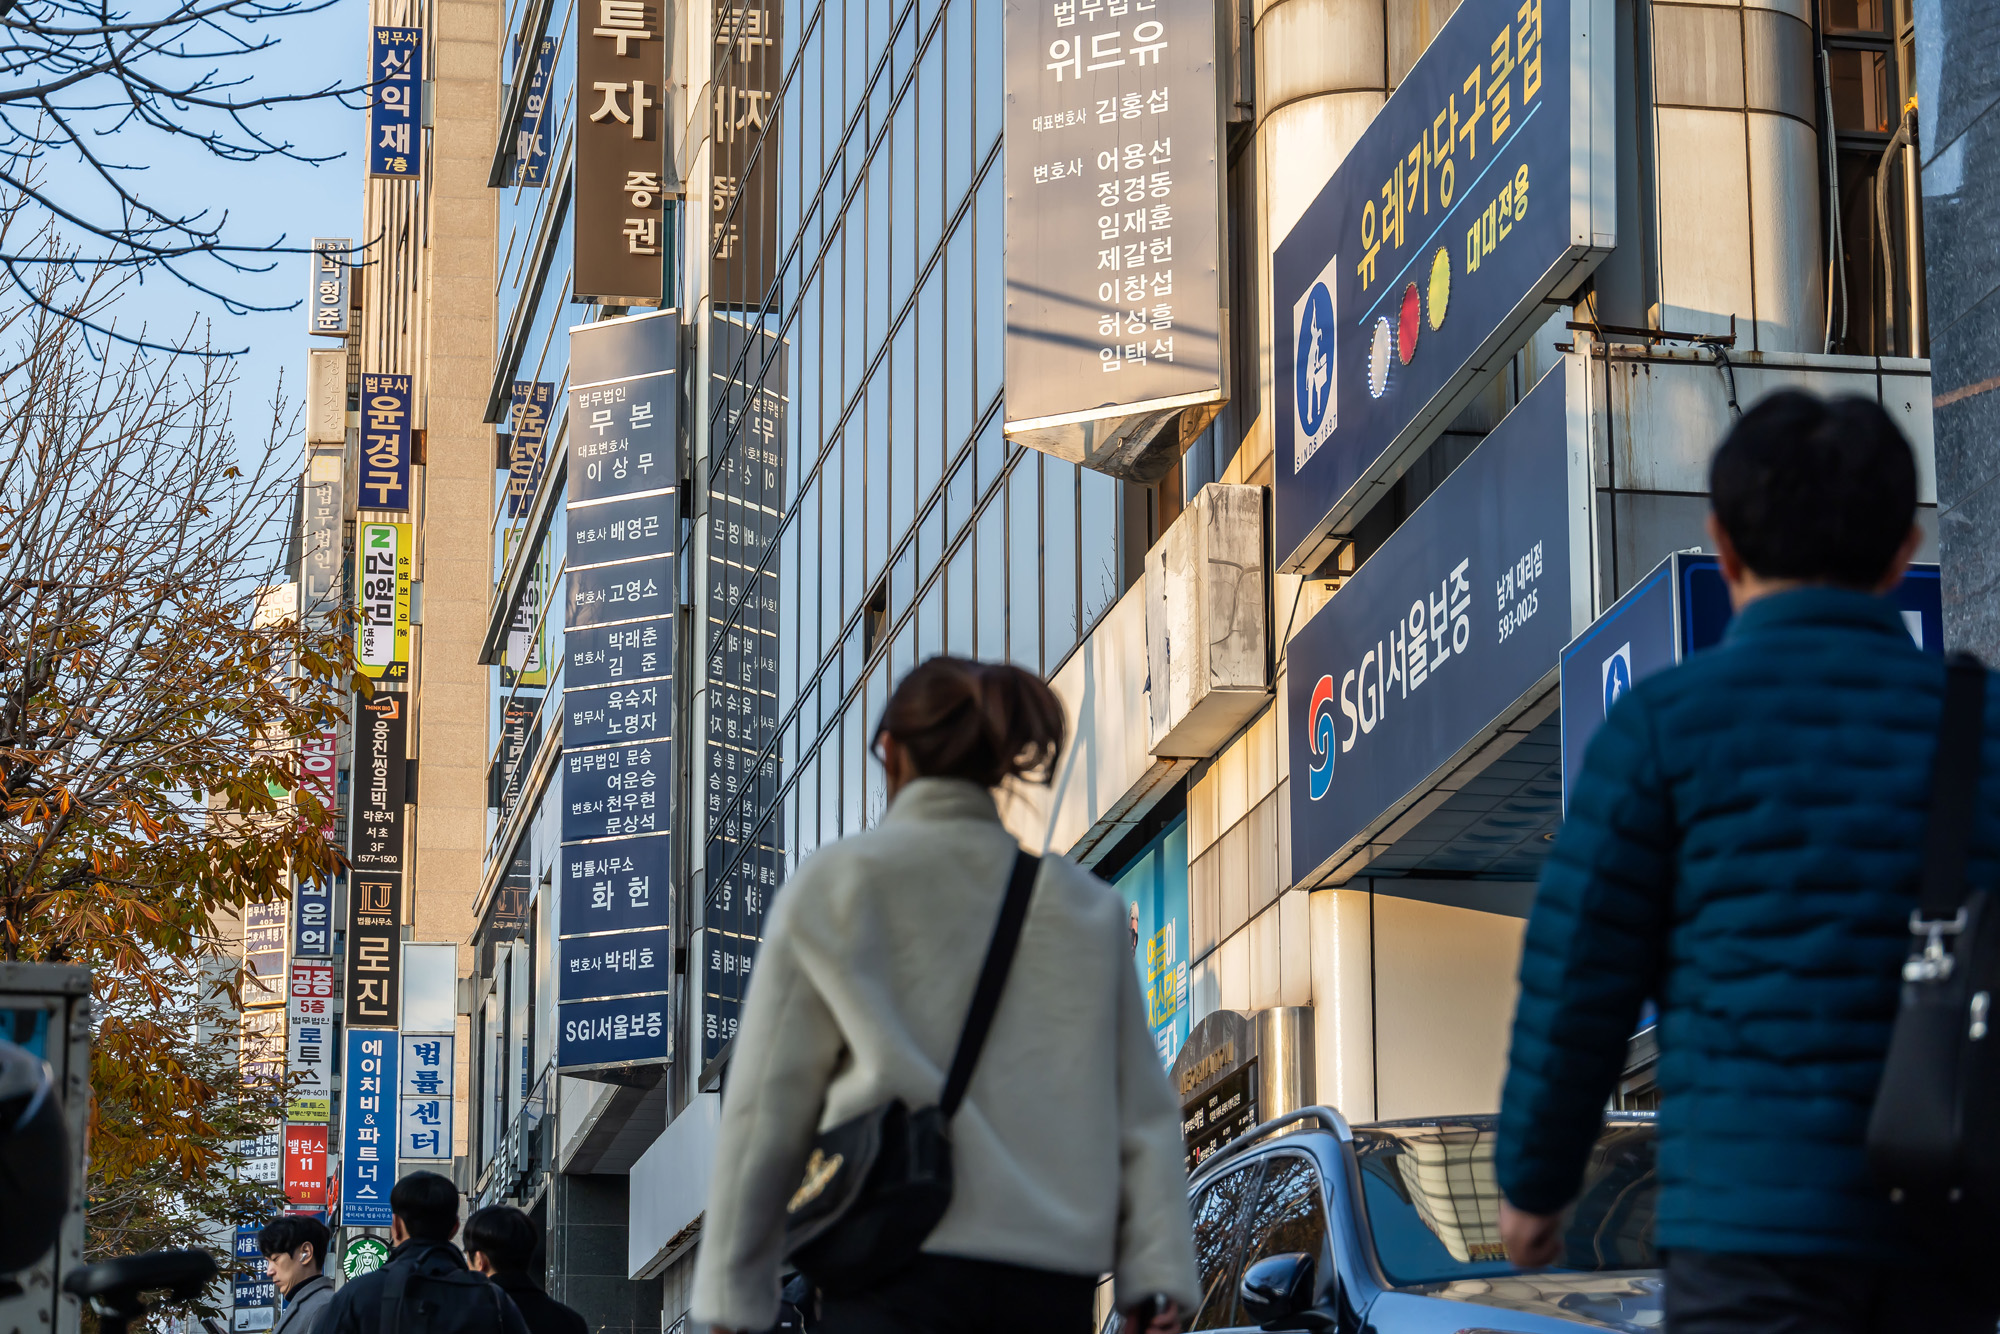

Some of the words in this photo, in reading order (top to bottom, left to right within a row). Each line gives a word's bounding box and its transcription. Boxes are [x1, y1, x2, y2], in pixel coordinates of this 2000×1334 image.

[378, 31, 418, 46] 법무사
[1046, 20, 1168, 82] 위드유
[380, 50, 411, 154] 신익재
[1032, 108, 1087, 133] 대표변호사
[1095, 87, 1169, 124] 김홍섭
[384, 158, 407, 172] 7층
[1033, 158, 1084, 185] 변호사
[1097, 137, 1172, 173] 어용선
[1097, 171, 1173, 207] 정경동
[623, 171, 660, 255] 증권
[1097, 203, 1173, 240] 임재훈
[1466, 163, 1530, 275] 대대전용
[1097, 236, 1173, 271] 제갈헌
[316, 253, 341, 329] 박형준
[1098, 269, 1173, 304] 이창섭
[1097, 302, 1174, 337] 허성흠
[1099, 336, 1174, 373] 임택석
[324, 358, 342, 430] 정신건강
[365, 377, 408, 394] 법무사
[579, 386, 627, 409] 법무법인
[1320, 414, 1336, 442] 1897
[365, 396, 405, 504] 윤경구
[578, 438, 629, 458] 대표변호사
[314, 485, 334, 569] 법무법인
[576, 527, 607, 544] 변호사
[610, 515, 659, 542] 배영곤
[1516, 540, 1543, 590] 대리점
[364, 551, 394, 627] 김형민
[575, 589, 606, 606] 변호사
[608, 578, 659, 603] 고영소
[1498, 588, 1539, 644] 593-0025
[362, 627, 376, 658] 변호사
[608, 626, 658, 651] 박래춘
[574, 650, 605, 666] 변호사
[1340, 557, 1471, 753] SGI서울보증
[389, 665, 406, 677] 4F
[607, 686, 658, 711] 육숙자
[573, 709, 605, 726] 법무사
[606, 711, 657, 737] 노명자
[371, 720, 389, 810] 웅진씽크빅
[570, 751, 620, 774] 법무법인
[626, 748, 652, 767] 문승
[607, 769, 657, 791] 여운승
[572, 800, 603, 816] 변호사
[606, 790, 656, 814] 천우현
[363, 811, 394, 823] 라운지
[605, 814, 656, 835] 문상석
[366, 827, 389, 839] 서초
[357, 855, 398, 864] 1577-1500
[370, 843, 384, 852] 3F
[571, 856, 634, 879] 법률사무소
[357, 917, 393, 926] 법률사무소
[570, 956, 602, 973] 변호사
[605, 947, 655, 973] 박태호
[1147, 917, 1176, 983] 연금이
[293, 969, 332, 996] 공증
[356, 937, 390, 1016] 로진
[300, 1000, 325, 1014] 5층
[1147, 960, 1187, 1029] 자신감을
[292, 1017, 329, 1025] 법무법인
[566, 1012, 663, 1042] SGI서울보증
[298, 1027, 322, 1085] 로투스
[287, 1139, 325, 1155] 밸런스
[300, 1158, 313, 1170] 11
[301, 1191, 311, 1199] B1
